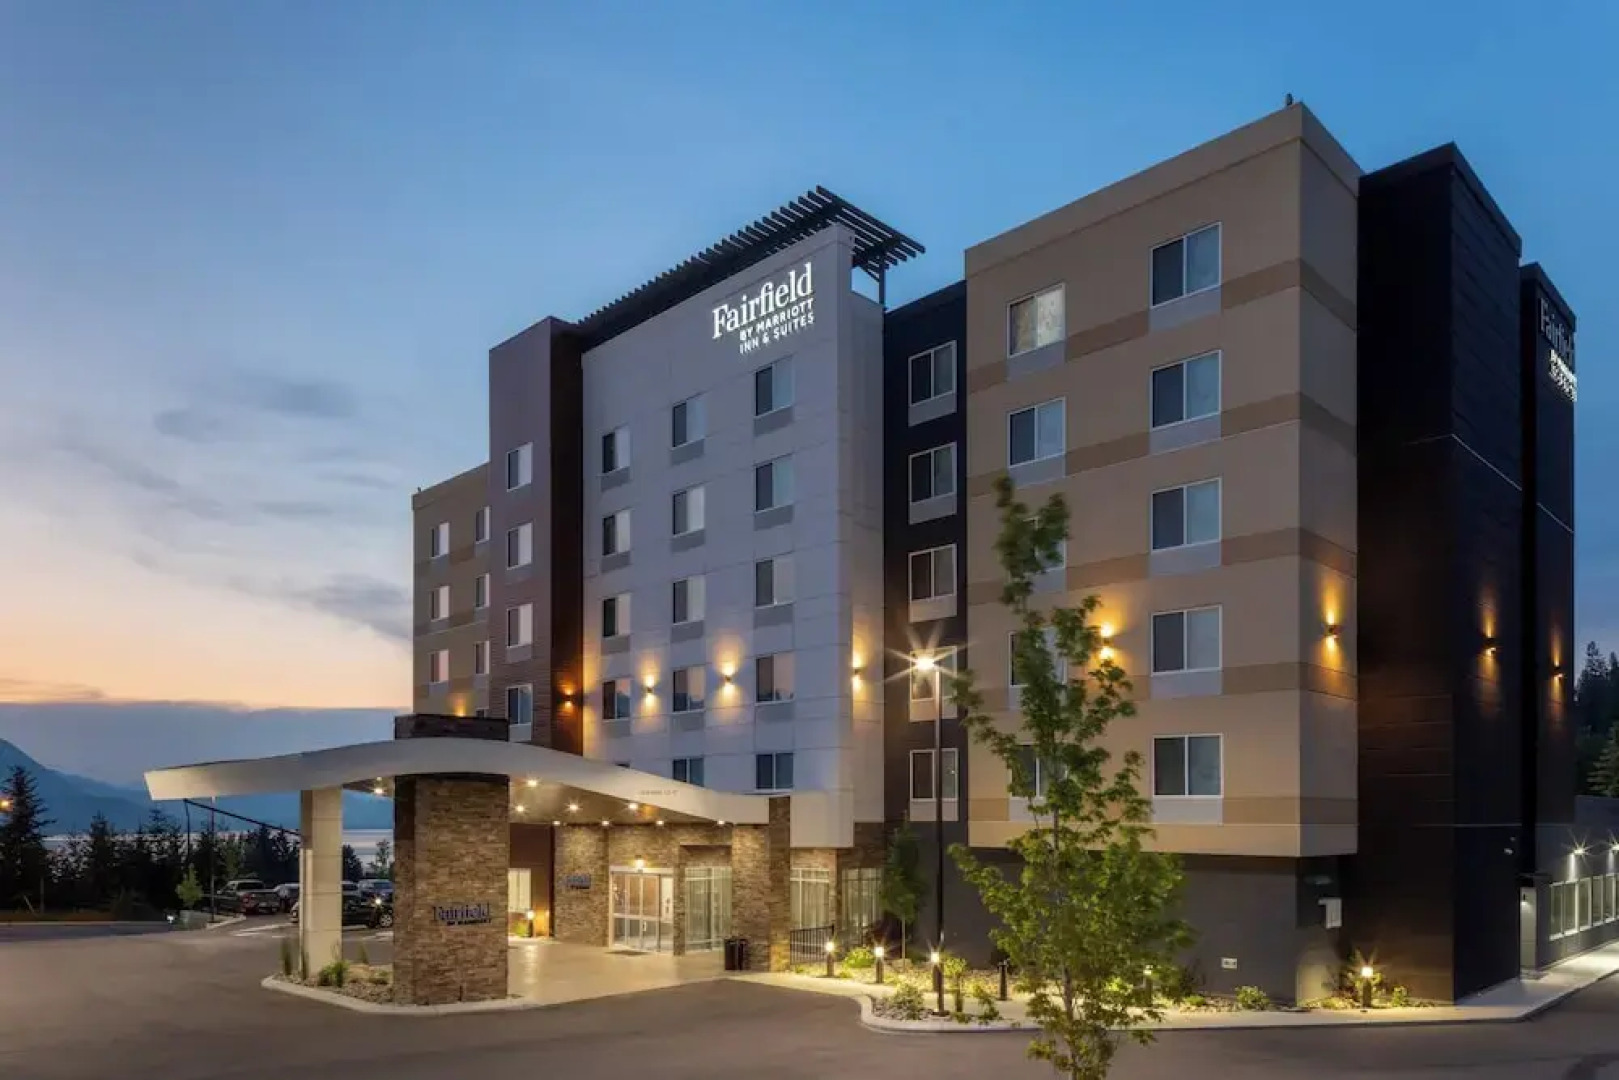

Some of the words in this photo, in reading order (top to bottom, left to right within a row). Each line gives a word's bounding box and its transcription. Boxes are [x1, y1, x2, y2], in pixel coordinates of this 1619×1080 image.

[712, 262, 812, 339] Fairfield
[740, 327, 753, 341] BY
[757, 298, 814, 334] MARRIOTT
[740, 336, 759, 354] INN
[762, 331, 770, 345] &
[773, 312, 814, 341] SUITES
[433, 902, 490, 921] Fairfield
